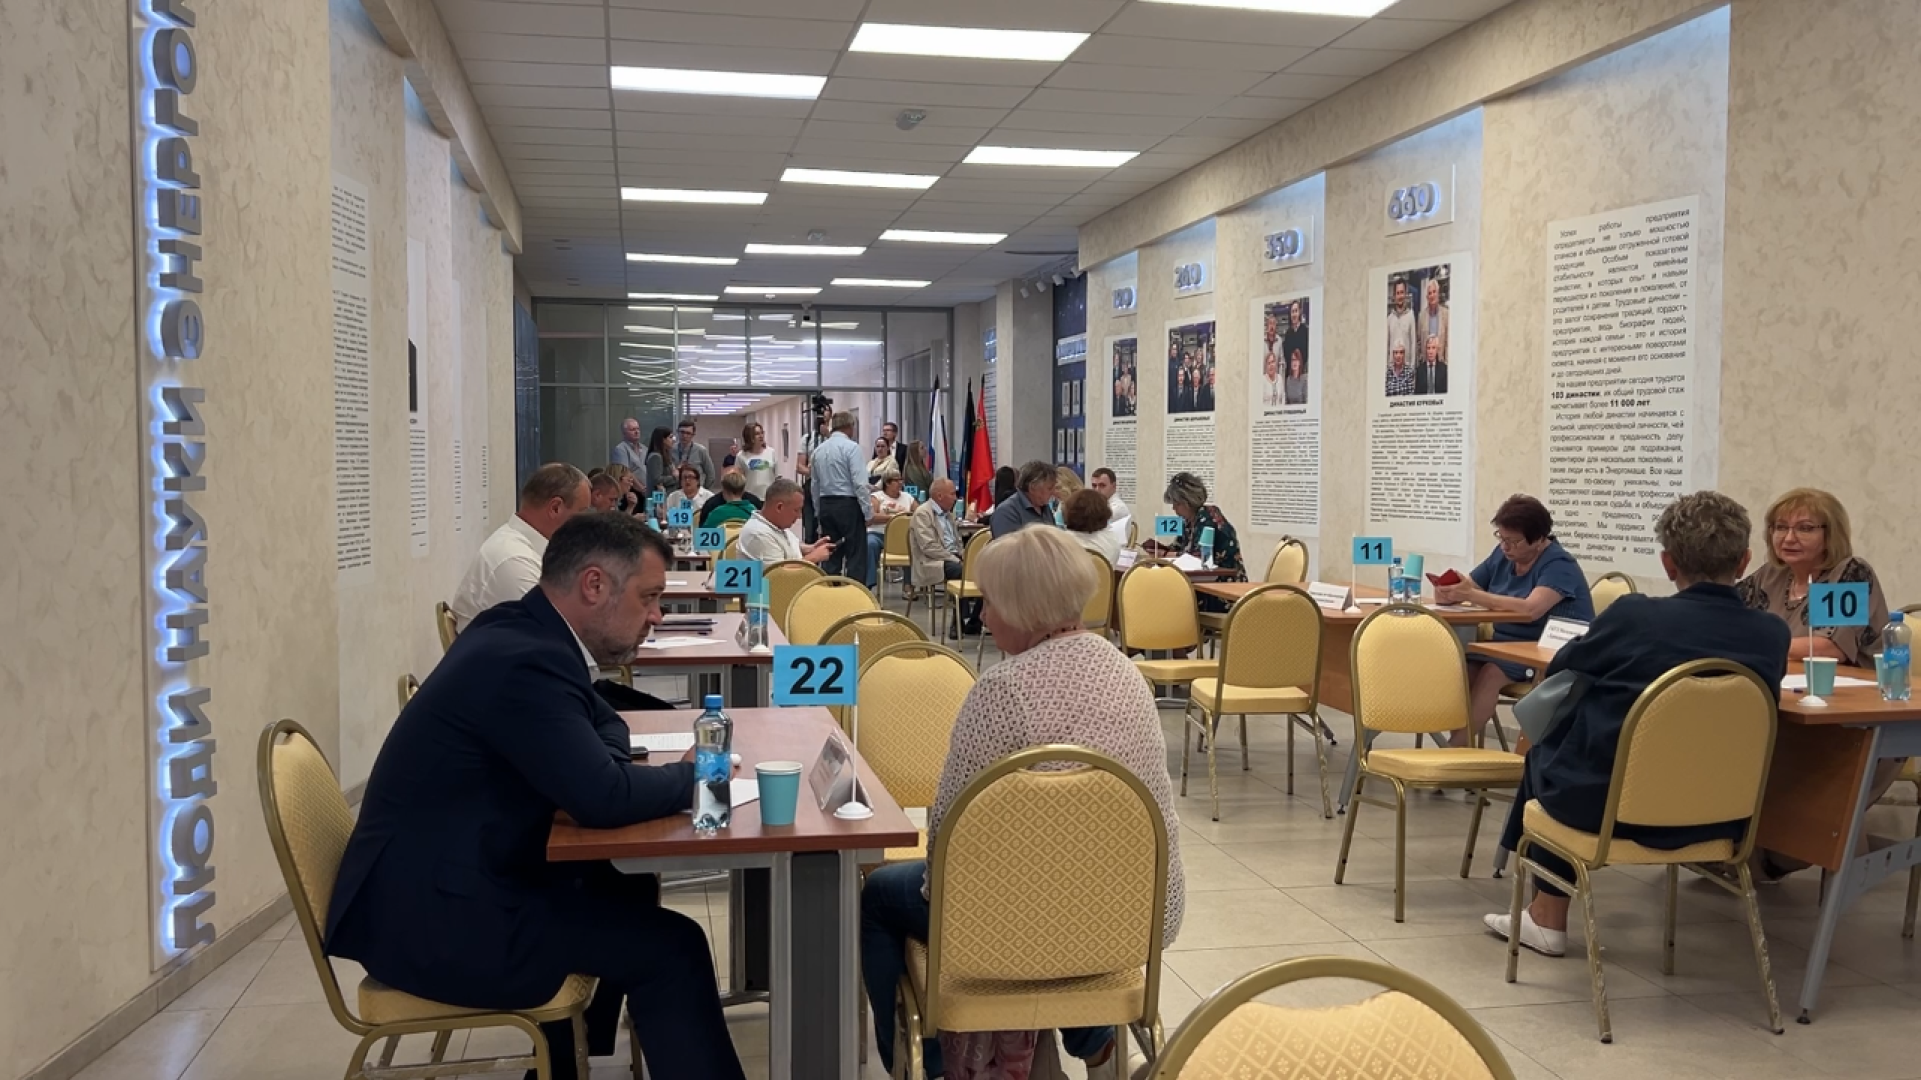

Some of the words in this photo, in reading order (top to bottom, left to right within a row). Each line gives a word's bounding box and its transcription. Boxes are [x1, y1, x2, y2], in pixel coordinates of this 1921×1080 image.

[1387, 183, 1434, 219] 660
[163, 387, 209, 663] НАУКИ
[673, 512, 689, 524] 19
[1160, 519, 1178, 533] 12
[699, 532, 721, 547] 20
[1360, 542, 1384, 560] 11
[723, 566, 752, 588] 21
[1821, 590, 1858, 618] 10
[789, 656, 844, 695] 22
[168, 688, 218, 950] ЛЮДИ
